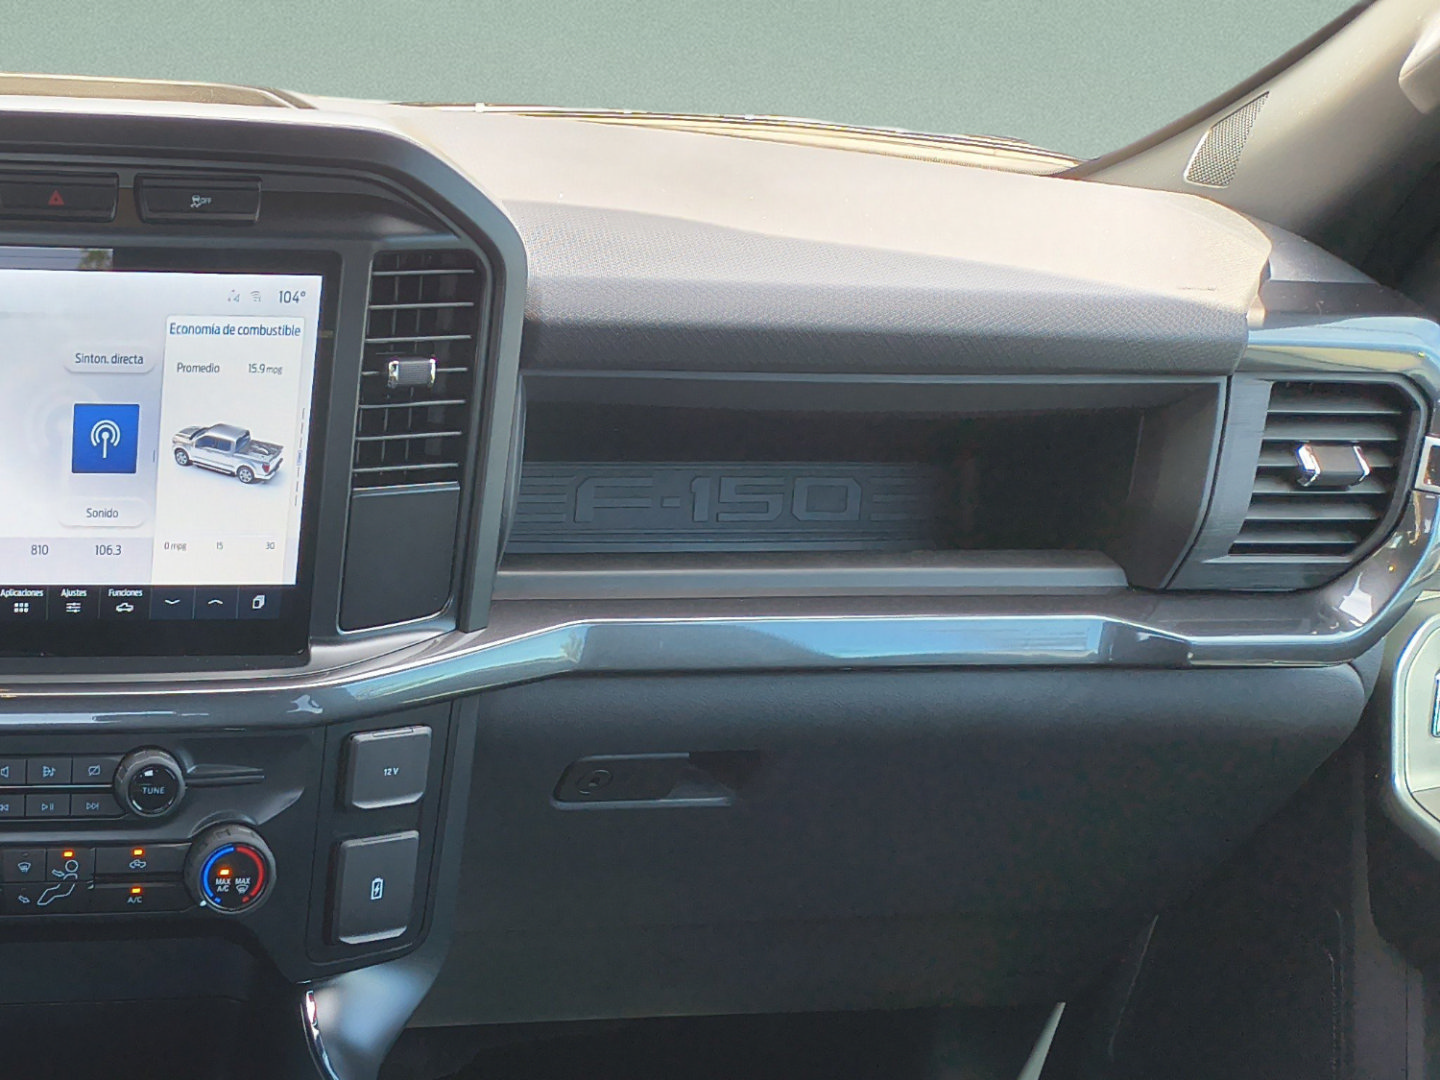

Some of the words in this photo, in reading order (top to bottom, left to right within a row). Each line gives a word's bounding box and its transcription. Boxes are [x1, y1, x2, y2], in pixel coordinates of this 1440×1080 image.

[279, 290, 306, 304] 104°
[169, 322, 221, 335] Economía
[222, 323, 236, 335] de
[237, 324, 302, 336] combustible
[75, 353, 109, 364] Sinton.
[111, 353, 144, 365] directa
[176, 362, 220, 373] Promedio
[574, 476, 861, 523] F-150
[86, 508, 119, 518] Sonido
[31, 545, 49, 556] 810
[95, 545, 122, 556] 106.3
[265, 542, 275, 550] 30
[0, 588, 44, 598] Aplicaciones
[60, 588, 87, 598] Ajustes
[108, 588, 143, 597] Funciones
[235, 877, 251, 885] MAX
[127, 896, 143, 904] A/C
